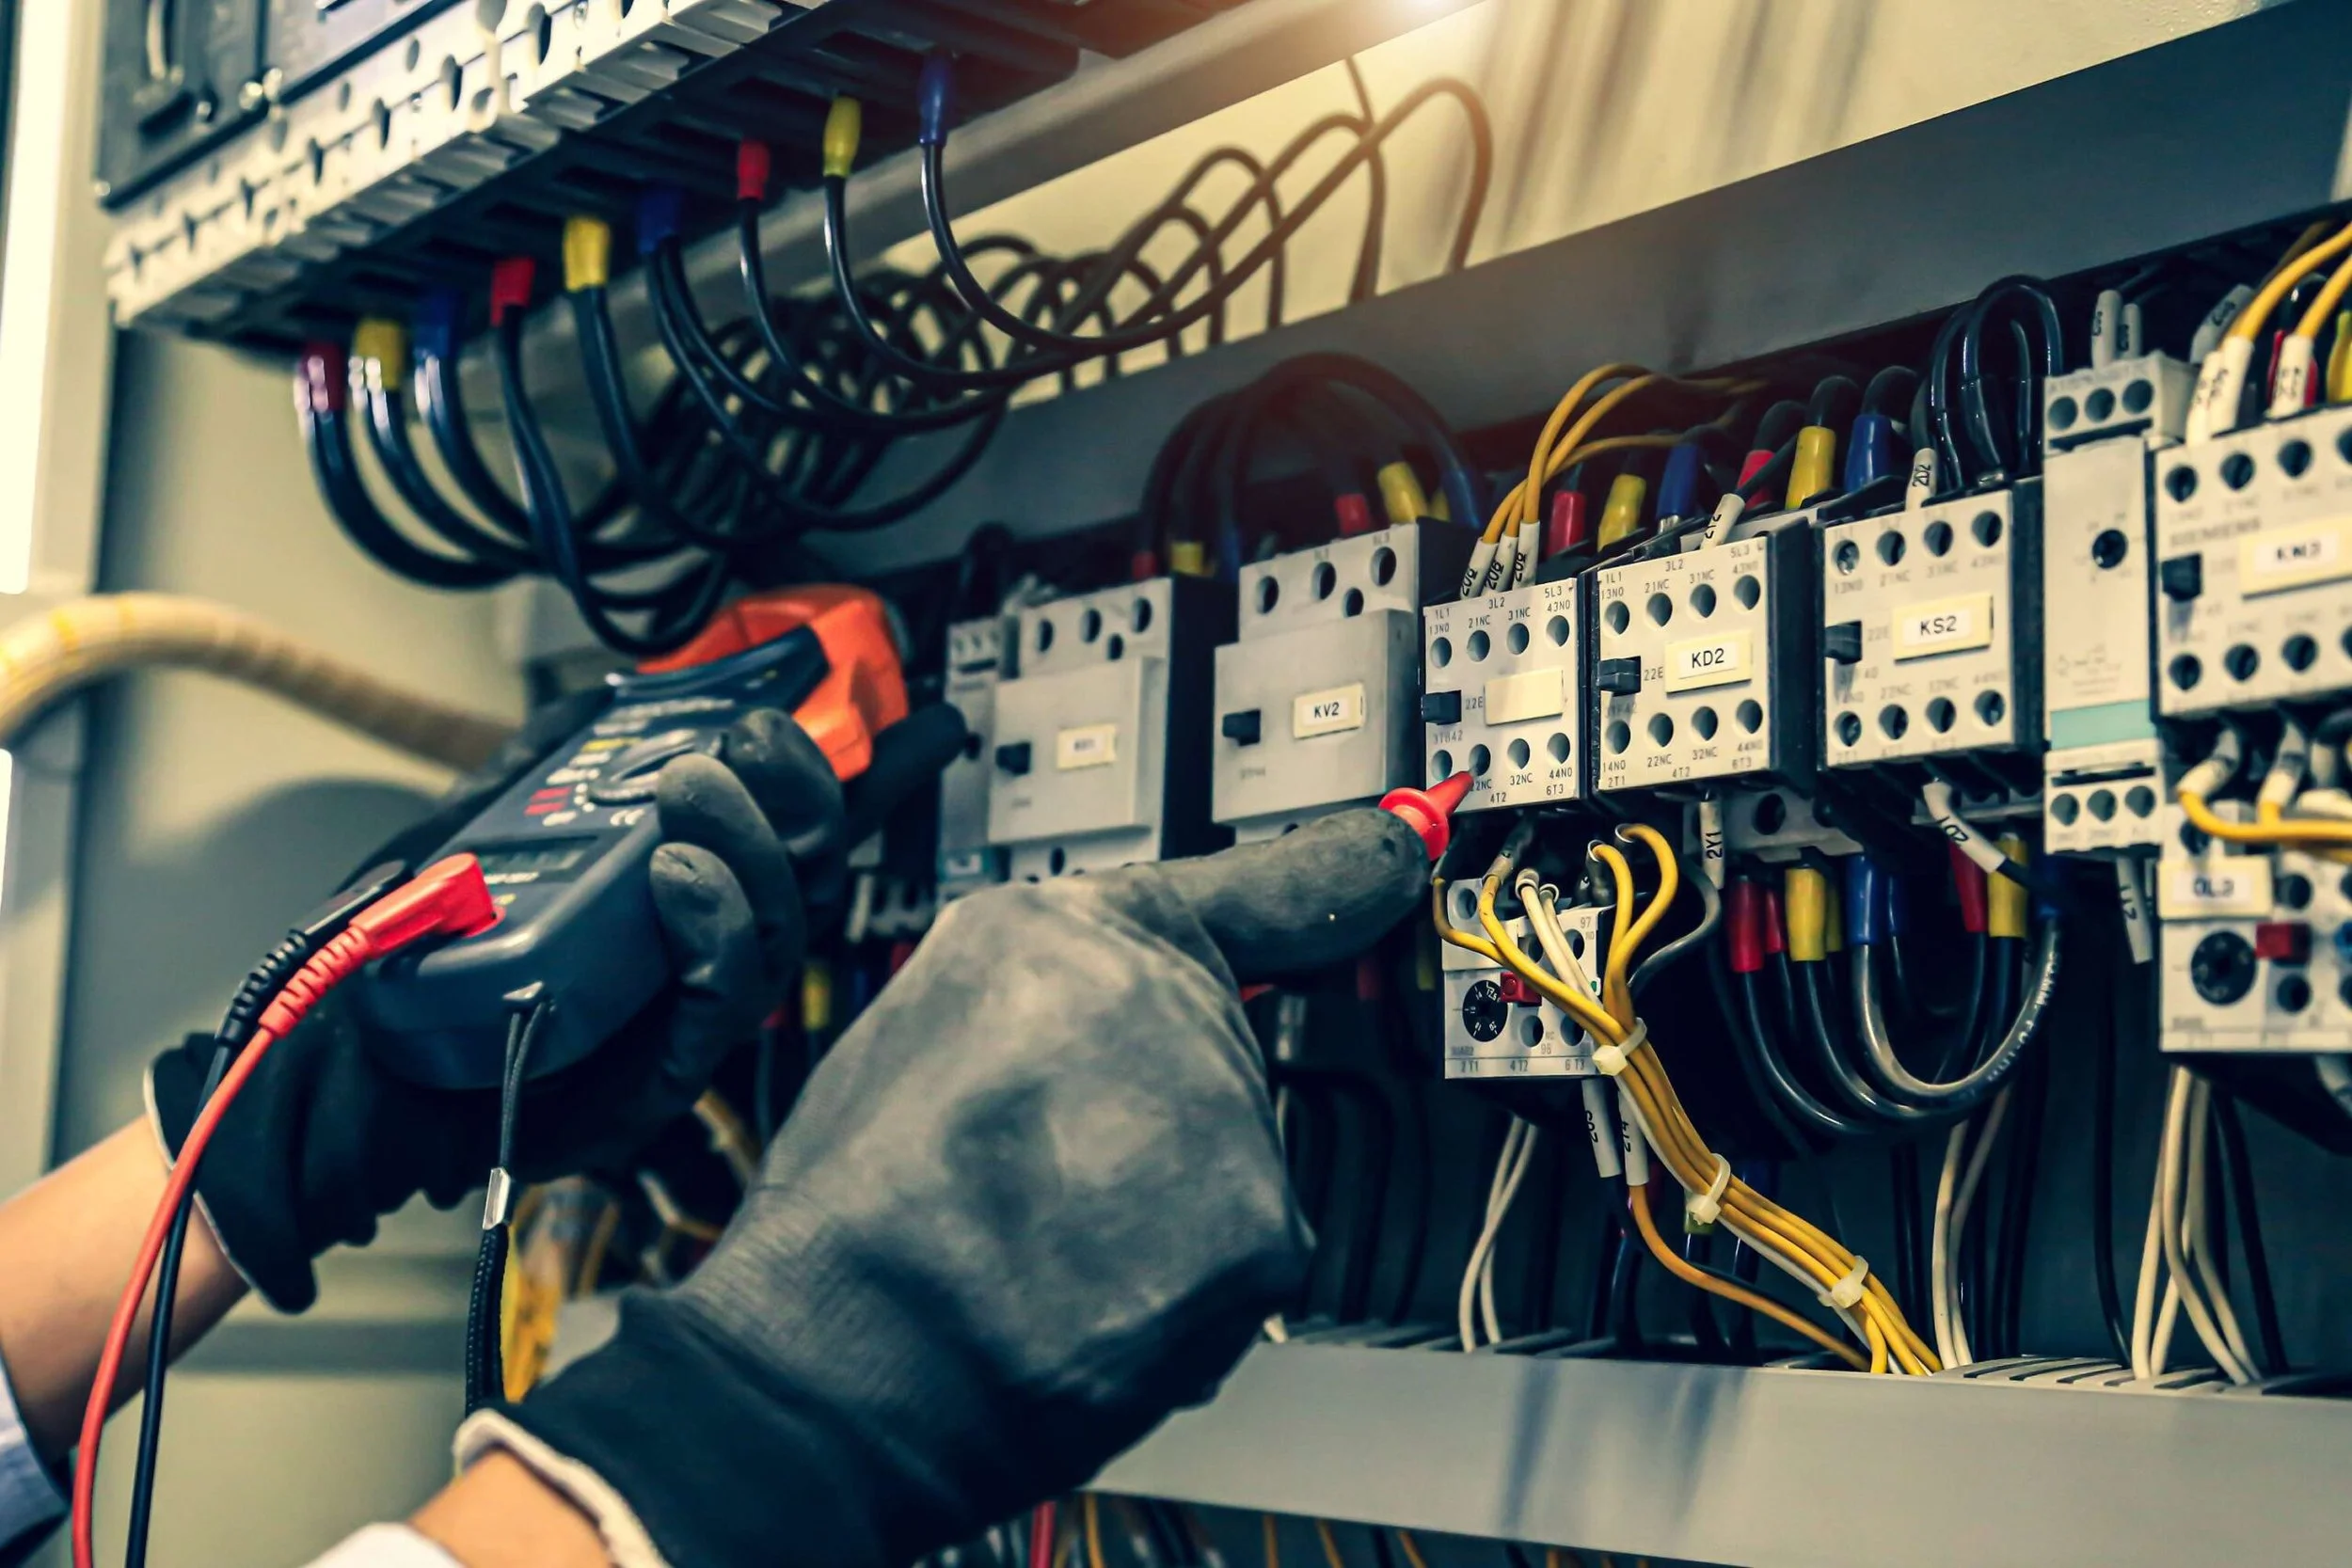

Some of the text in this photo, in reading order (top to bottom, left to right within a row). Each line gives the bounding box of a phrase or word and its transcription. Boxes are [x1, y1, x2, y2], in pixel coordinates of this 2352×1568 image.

[1730, 546, 1750, 558] 5L3
[1665, 559, 1684, 572] 3L2
[1605, 572, 1622, 584] 1L1
[1690, 569, 1715, 584] 31NC
[1545, 586, 1562, 598] 5L3
[1645, 579, 1670, 594] 21NC
[1488, 597, 1505, 610] 3L2
[1435, 608, 1450, 620] 1L1
[1508, 608, 1531, 621] 31NC
[1468, 615, 1491, 628] 21NC
[1919, 615, 1957, 637] KS2
[1692, 648, 1724, 669] KD2
[1644, 667, 1663, 681] 22E
[1465, 697, 1484, 710] 22E
[1314, 702, 1340, 719] KV2
[1692, 747, 1718, 760] 32NC
[1647, 753, 1672, 768] 22NC
[1672, 767, 1691, 778] 4T2
[1472, 779, 1492, 792] 2NC
[1509, 773, 1533, 786] 32NC
[1608, 775, 1626, 788] 2T1
[1546, 784, 1564, 796] 6T3
[1490, 792, 1507, 803] 4T2
[1706, 831, 1723, 859] 2Y1
[1581, 916, 1591, 929] 97
